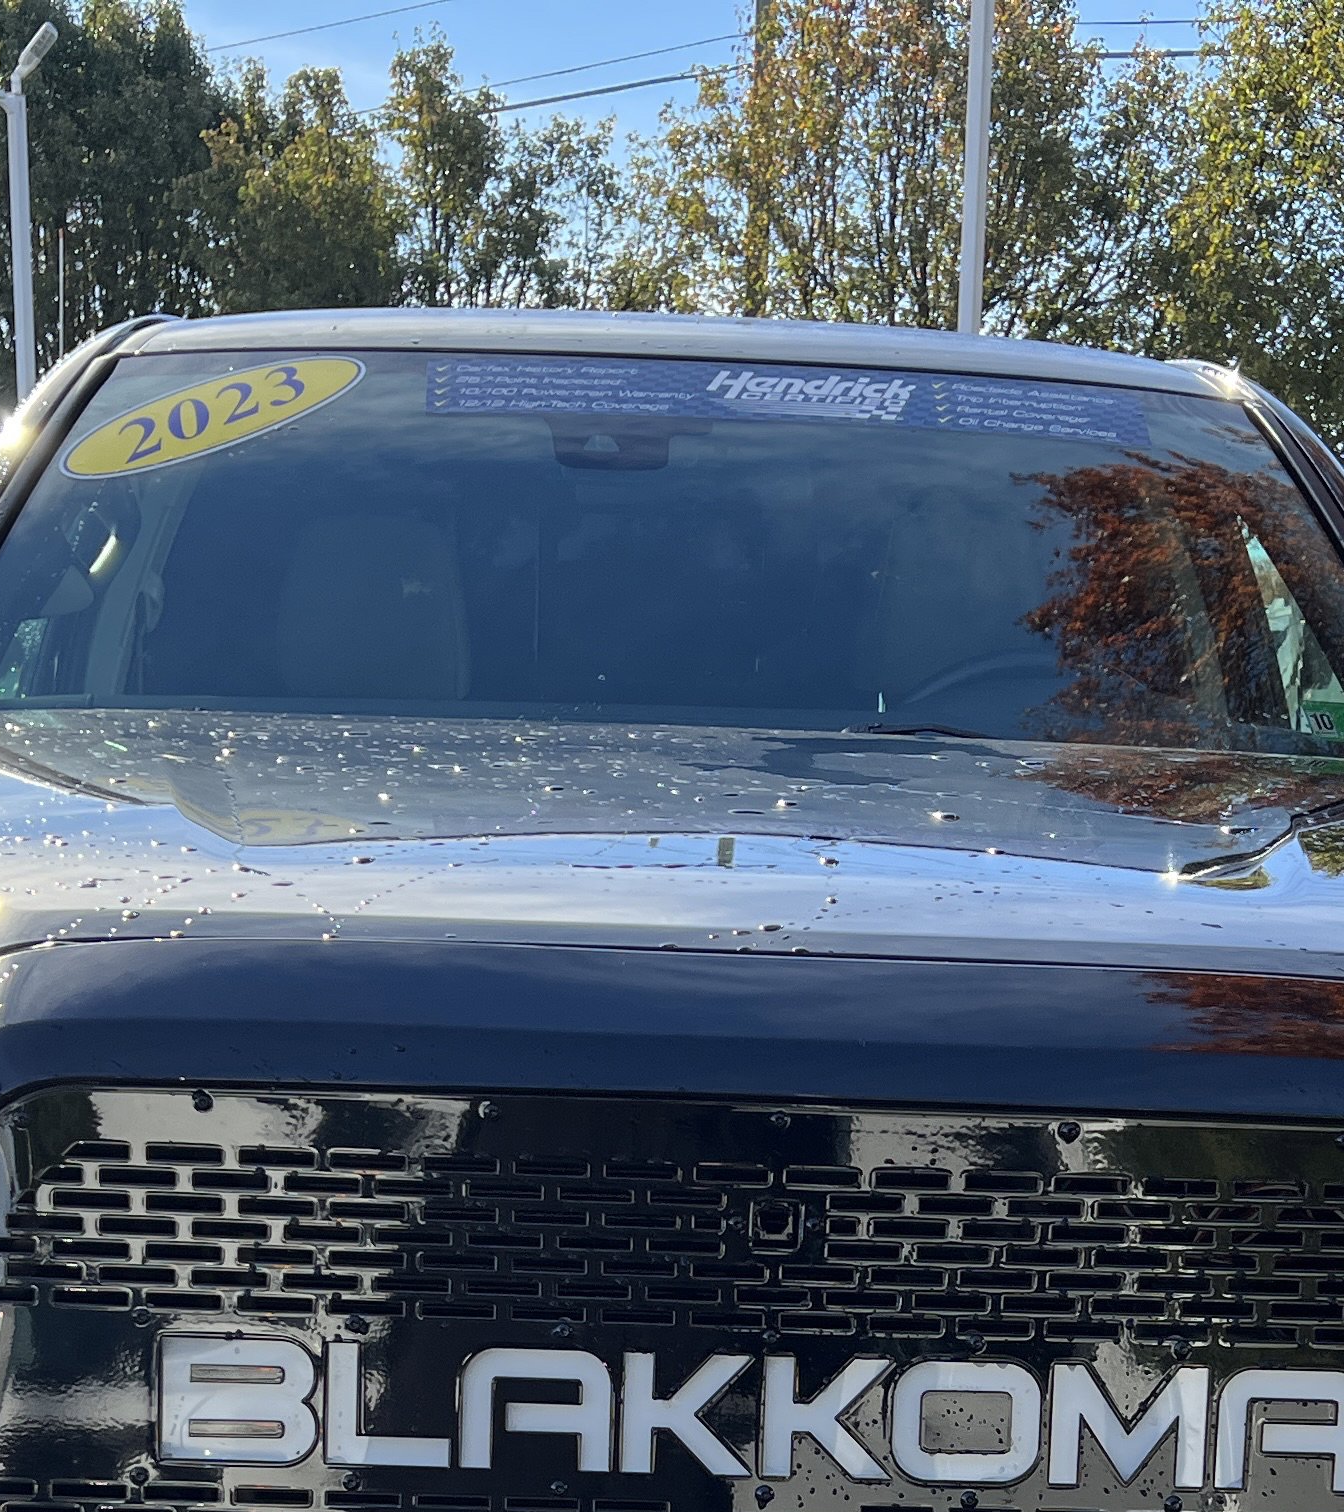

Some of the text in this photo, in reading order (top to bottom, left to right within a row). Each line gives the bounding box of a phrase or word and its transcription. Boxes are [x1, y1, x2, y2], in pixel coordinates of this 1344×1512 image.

[516, 365, 576, 375] History
[580, 366, 638, 375] Report
[706, 370, 916, 400] Hendrick
[952, 383, 1023, 396] Roadside
[459, 387, 696, 401] 10/100 Powertrain Warranty
[957, 394, 984, 404] Trip
[510, 399, 586, 410] High-Tech
[591, 400, 671, 411] Coverage
[118, 366, 306, 464] 2023
[956, 405, 1090, 423] Rental Coverage
[958, 417, 1118, 438] Oil Change Services
[1309, 712, 1335, 730] 10
